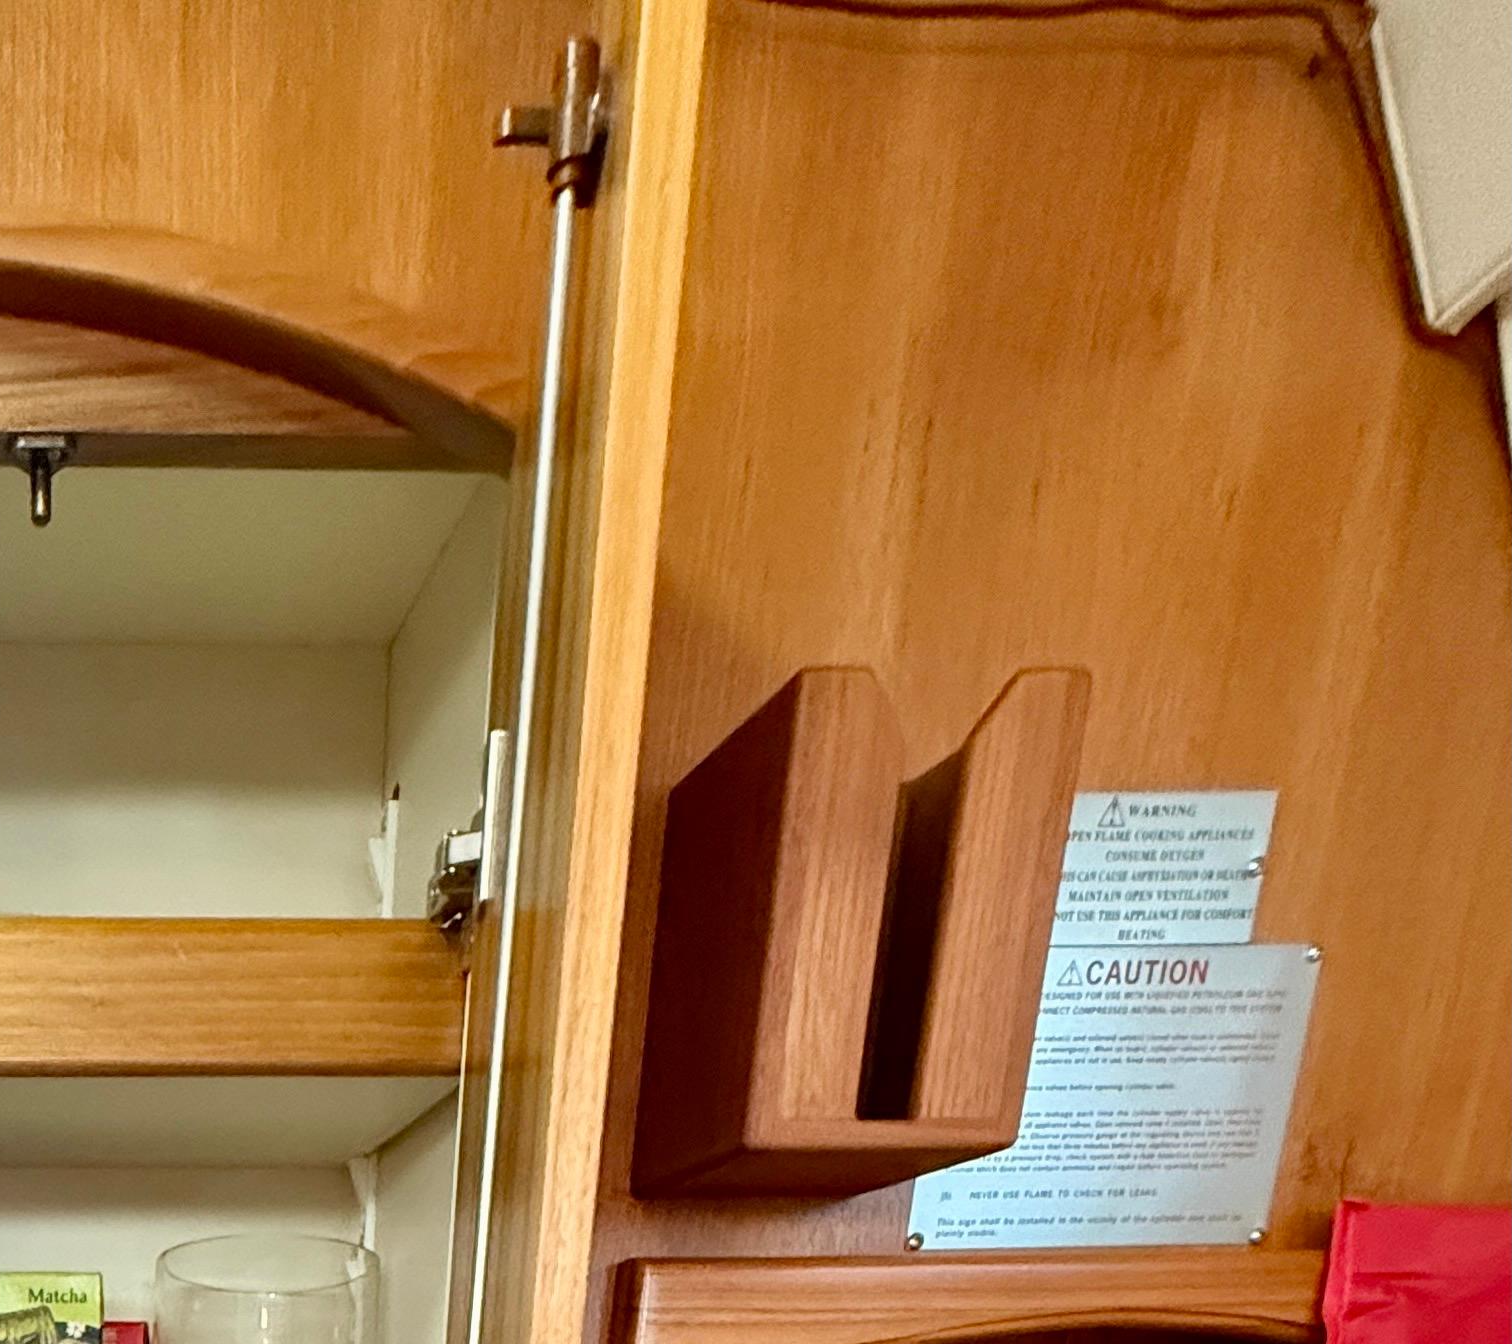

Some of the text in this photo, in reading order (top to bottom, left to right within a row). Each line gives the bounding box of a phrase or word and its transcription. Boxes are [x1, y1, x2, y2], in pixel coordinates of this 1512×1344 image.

[1128, 803, 1196, 817] WARNING
[1070, 829, 1092, 842] PEN
[1086, 959, 1209, 985] CAUTION
[28, 1287, 87, 1305] Matcha
